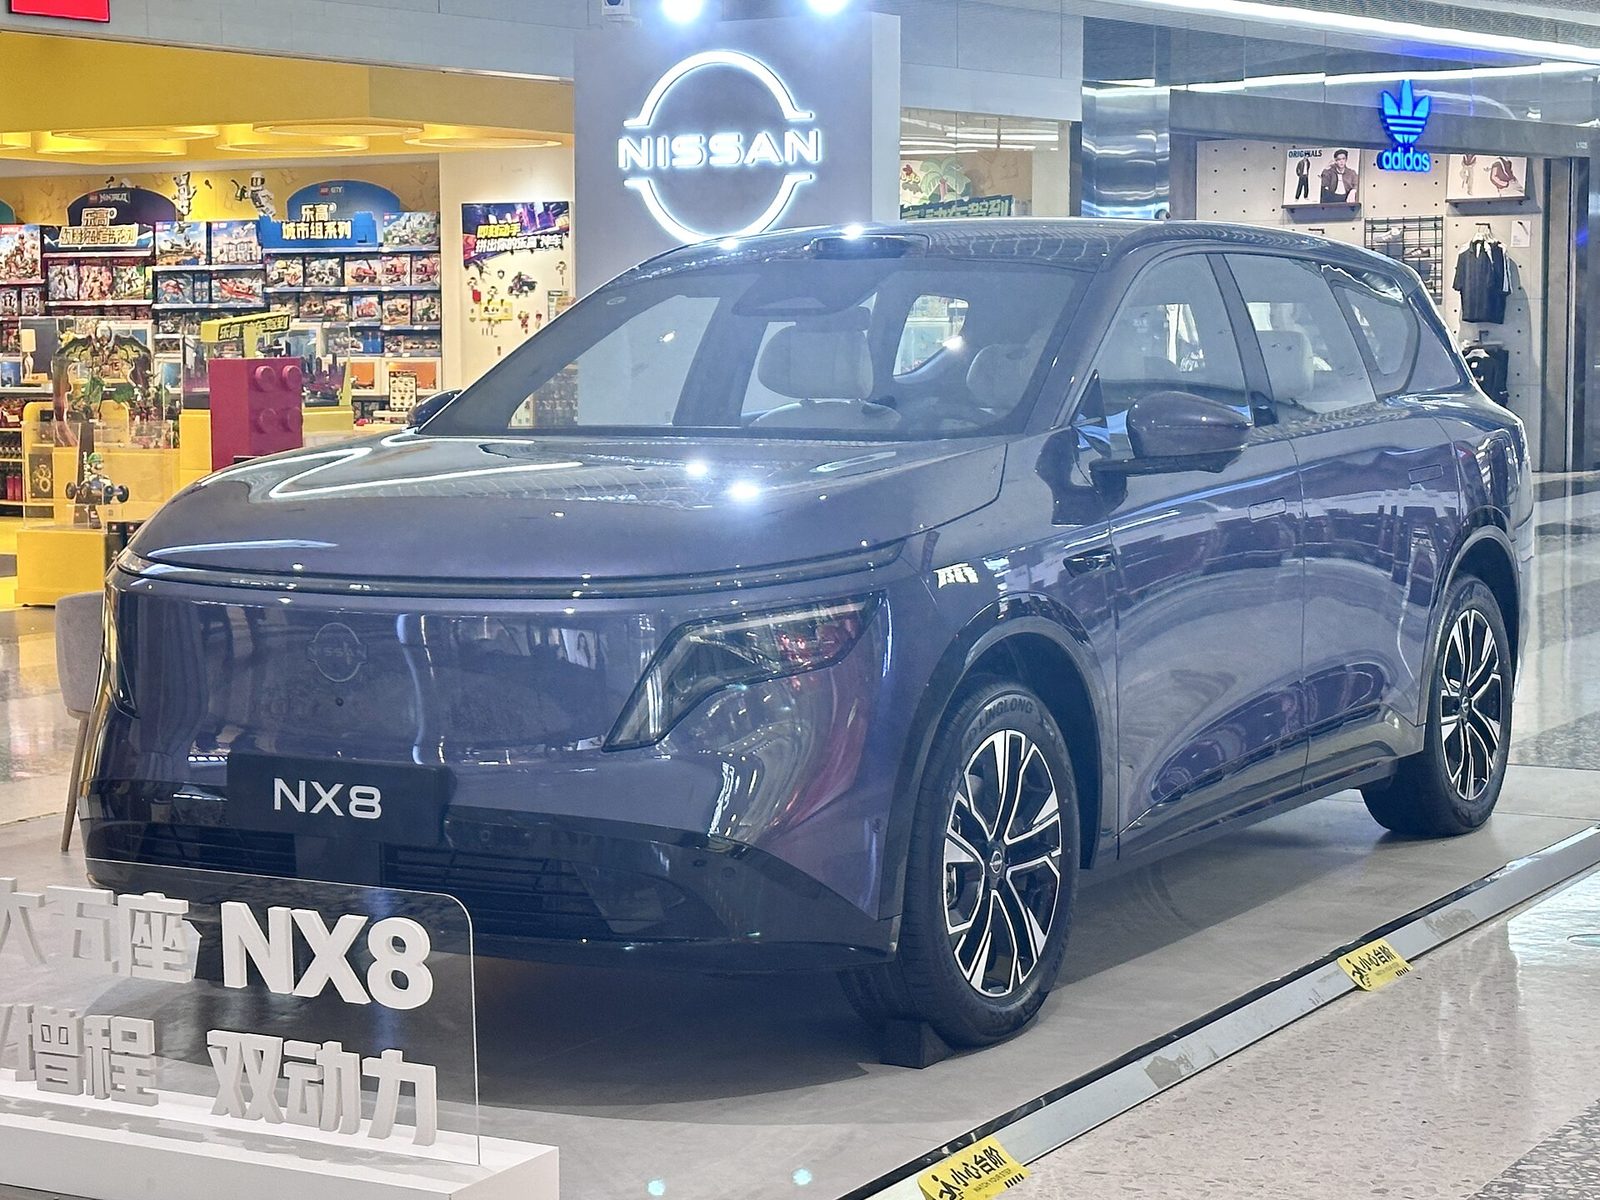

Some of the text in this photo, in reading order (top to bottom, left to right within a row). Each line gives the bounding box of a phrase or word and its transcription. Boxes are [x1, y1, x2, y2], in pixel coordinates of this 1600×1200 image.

[617, 130, 819, 169] NISSAN
[1382, 147, 1430, 171] adidas
[281, 219, 353, 240] 城市组系列
[301, 203, 329, 221] 乐高
[273, 778, 382, 819] NX8
[221, 901, 434, 1010] NX8
[1358, 944, 1397, 971] 小心台阶
[207, 1029, 437, 1146] 双动力
[950, 1145, 1008, 1187] 小心台阶
